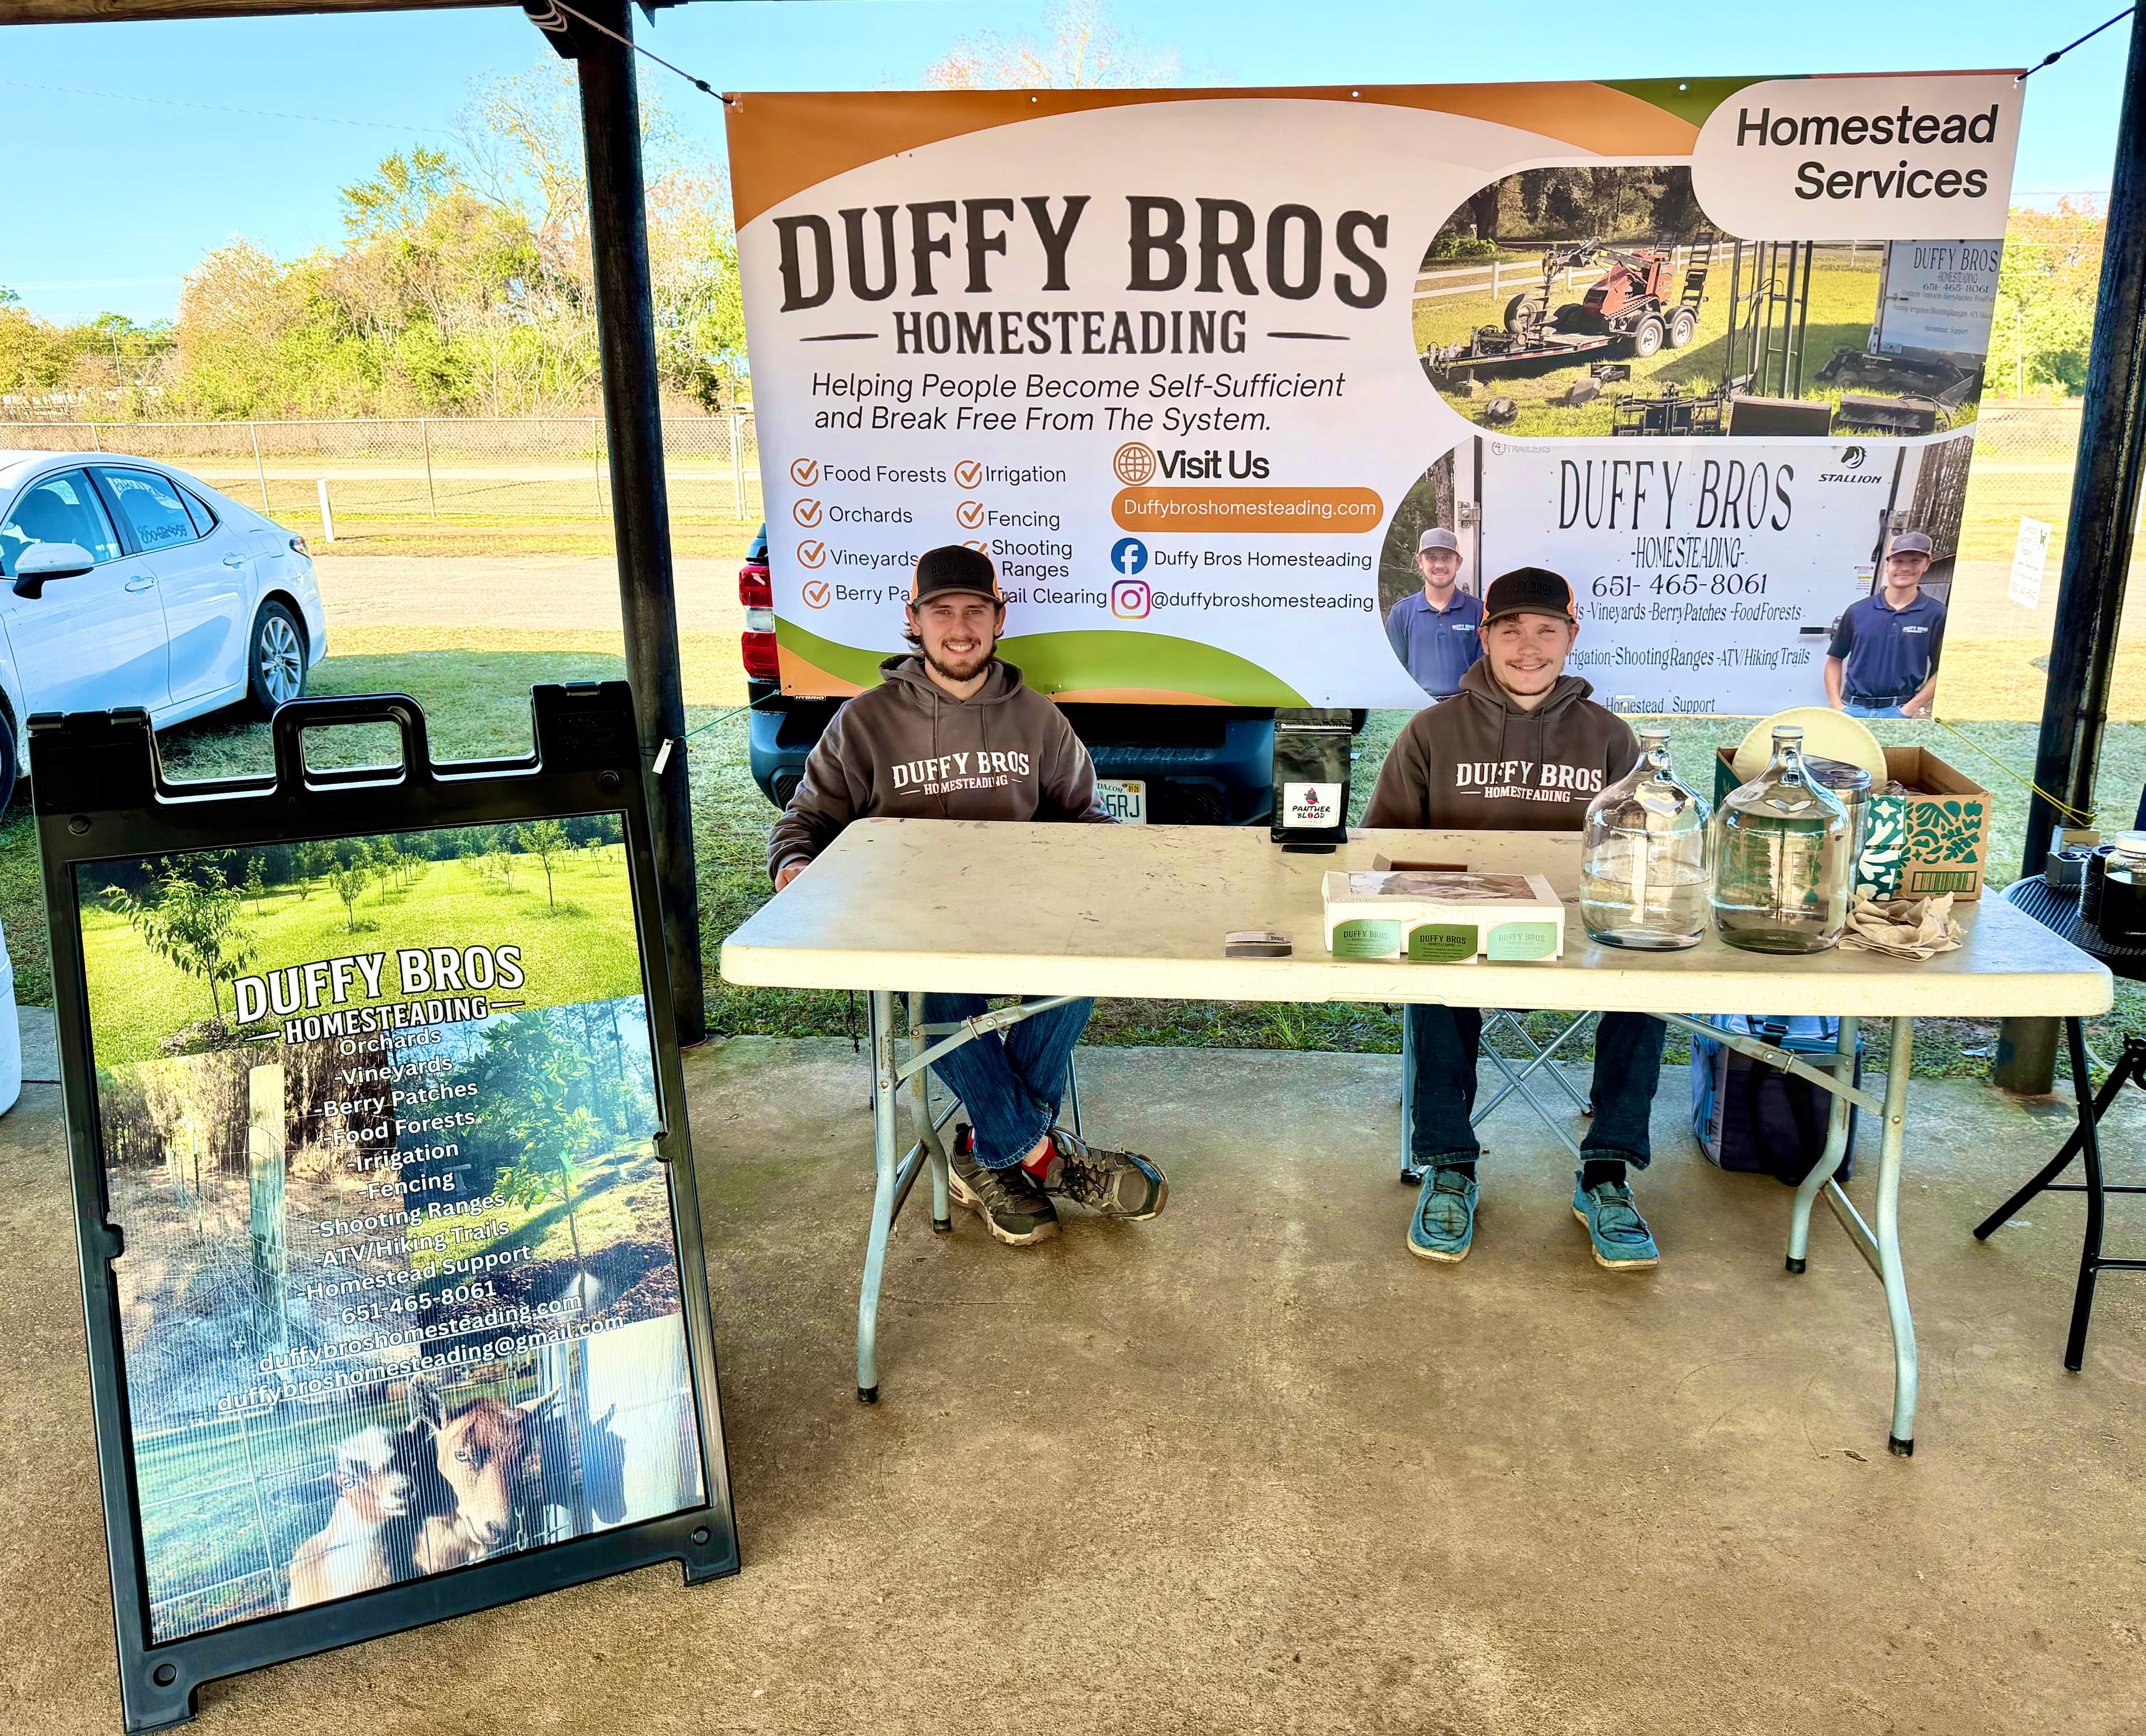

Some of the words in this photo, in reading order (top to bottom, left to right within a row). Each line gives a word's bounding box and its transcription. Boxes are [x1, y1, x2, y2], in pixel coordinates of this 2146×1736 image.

[1736, 104, 1999, 146] Homestead
[1794, 159, 1988, 200] Services
[772, 195, 1091, 313] DUFFY
[1125, 195, 1389, 309] BROS
[1914, 247, 1956, 269] DUFFY
[1960, 248, 1998, 272] BROS
[892, 310, 1246, 354] HOMESTEADING
[812, 373, 913, 403] Helping
[922, 373, 1016, 403] People
[1025, 374, 1140, 398] Become
[1148, 372, 1346, 398] Self-Sufficient
[814, 406, 863, 429] and
[872, 406, 948, 430] Break
[956, 407, 1017, 430] Free
[1025, 407, 1094, 430] From
[1103, 407, 1153, 431] The
[1162, 407, 1271, 437] System.
[824, 465, 871, 482] Food
[876, 466, 947, 483] Forests
[985, 466, 1066, 486] Irrigation
[1156, 450, 1222, 479] Visit
[1229, 450, 1270, 479] Us
[1819, 473, 1882, 484] STALLION
[1559, 459, 1682, 530] DUFFY
[1696, 459, 1794, 532] BROS
[829, 506, 913, 524] Orchards
[987, 510, 1060, 531] Fencing
[1124, 499, 1376, 519] Duffybroshomesteading.com
[830, 549, 918, 570] Vineyards
[992, 539, 1072, 559] Shooting
[1155, 551, 1199, 569] Duffy
[1204, 551, 1242, 566] Bros
[1248, 552, 1372, 570] Homesteading
[1001, 561, 1069, 581] Ranges
[835, 585, 882, 604] Berry
[1033, 588, 1107, 608] Clearing
[1151, 591, 1374, 612] @duffybroshomesteading
[1781, 647, 1810, 665] Trails
[1672, 696, 1716, 714] Support
[891, 752, 970, 789] DUFFY
[976, 751, 1029, 776] BROS
[1456, 760, 1533, 788] DUFFY
[1541, 763, 1602, 793] BROS
[924, 774, 1008, 796] HOMESTEADING
[1484, 786, 1570, 803] HOMESTEADING
[1343, 930, 1367, 938] DUFFY
[1369, 931, 1389, 940] BROS
[1446, 935, 1466, 945] BROS
[1499, 933, 1523, 942] DUFFY
[1525, 933, 1545, 942] BROS
[234, 952, 386, 1026] DUFFY
[397, 945, 525, 996] BROS
[284, 996, 488, 1045] HOMESTEADING
[339, 1028, 442, 1057] Orchards
[392, 1079, 478, 1108] Patches
[394, 1109, 476, 1137] Forests
[428, 1190, 506, 1221] Ranges
[450, 1218, 510, 1245] Trails
[441, 1245, 532, 1280] Support
[341, 1280, 497, 1326] 651-465-8061
[259, 1292, 582, 1373] duffybroshomesteading.com
[217, 1314, 625, 1414] duffybroshomesteading@gmail.com
